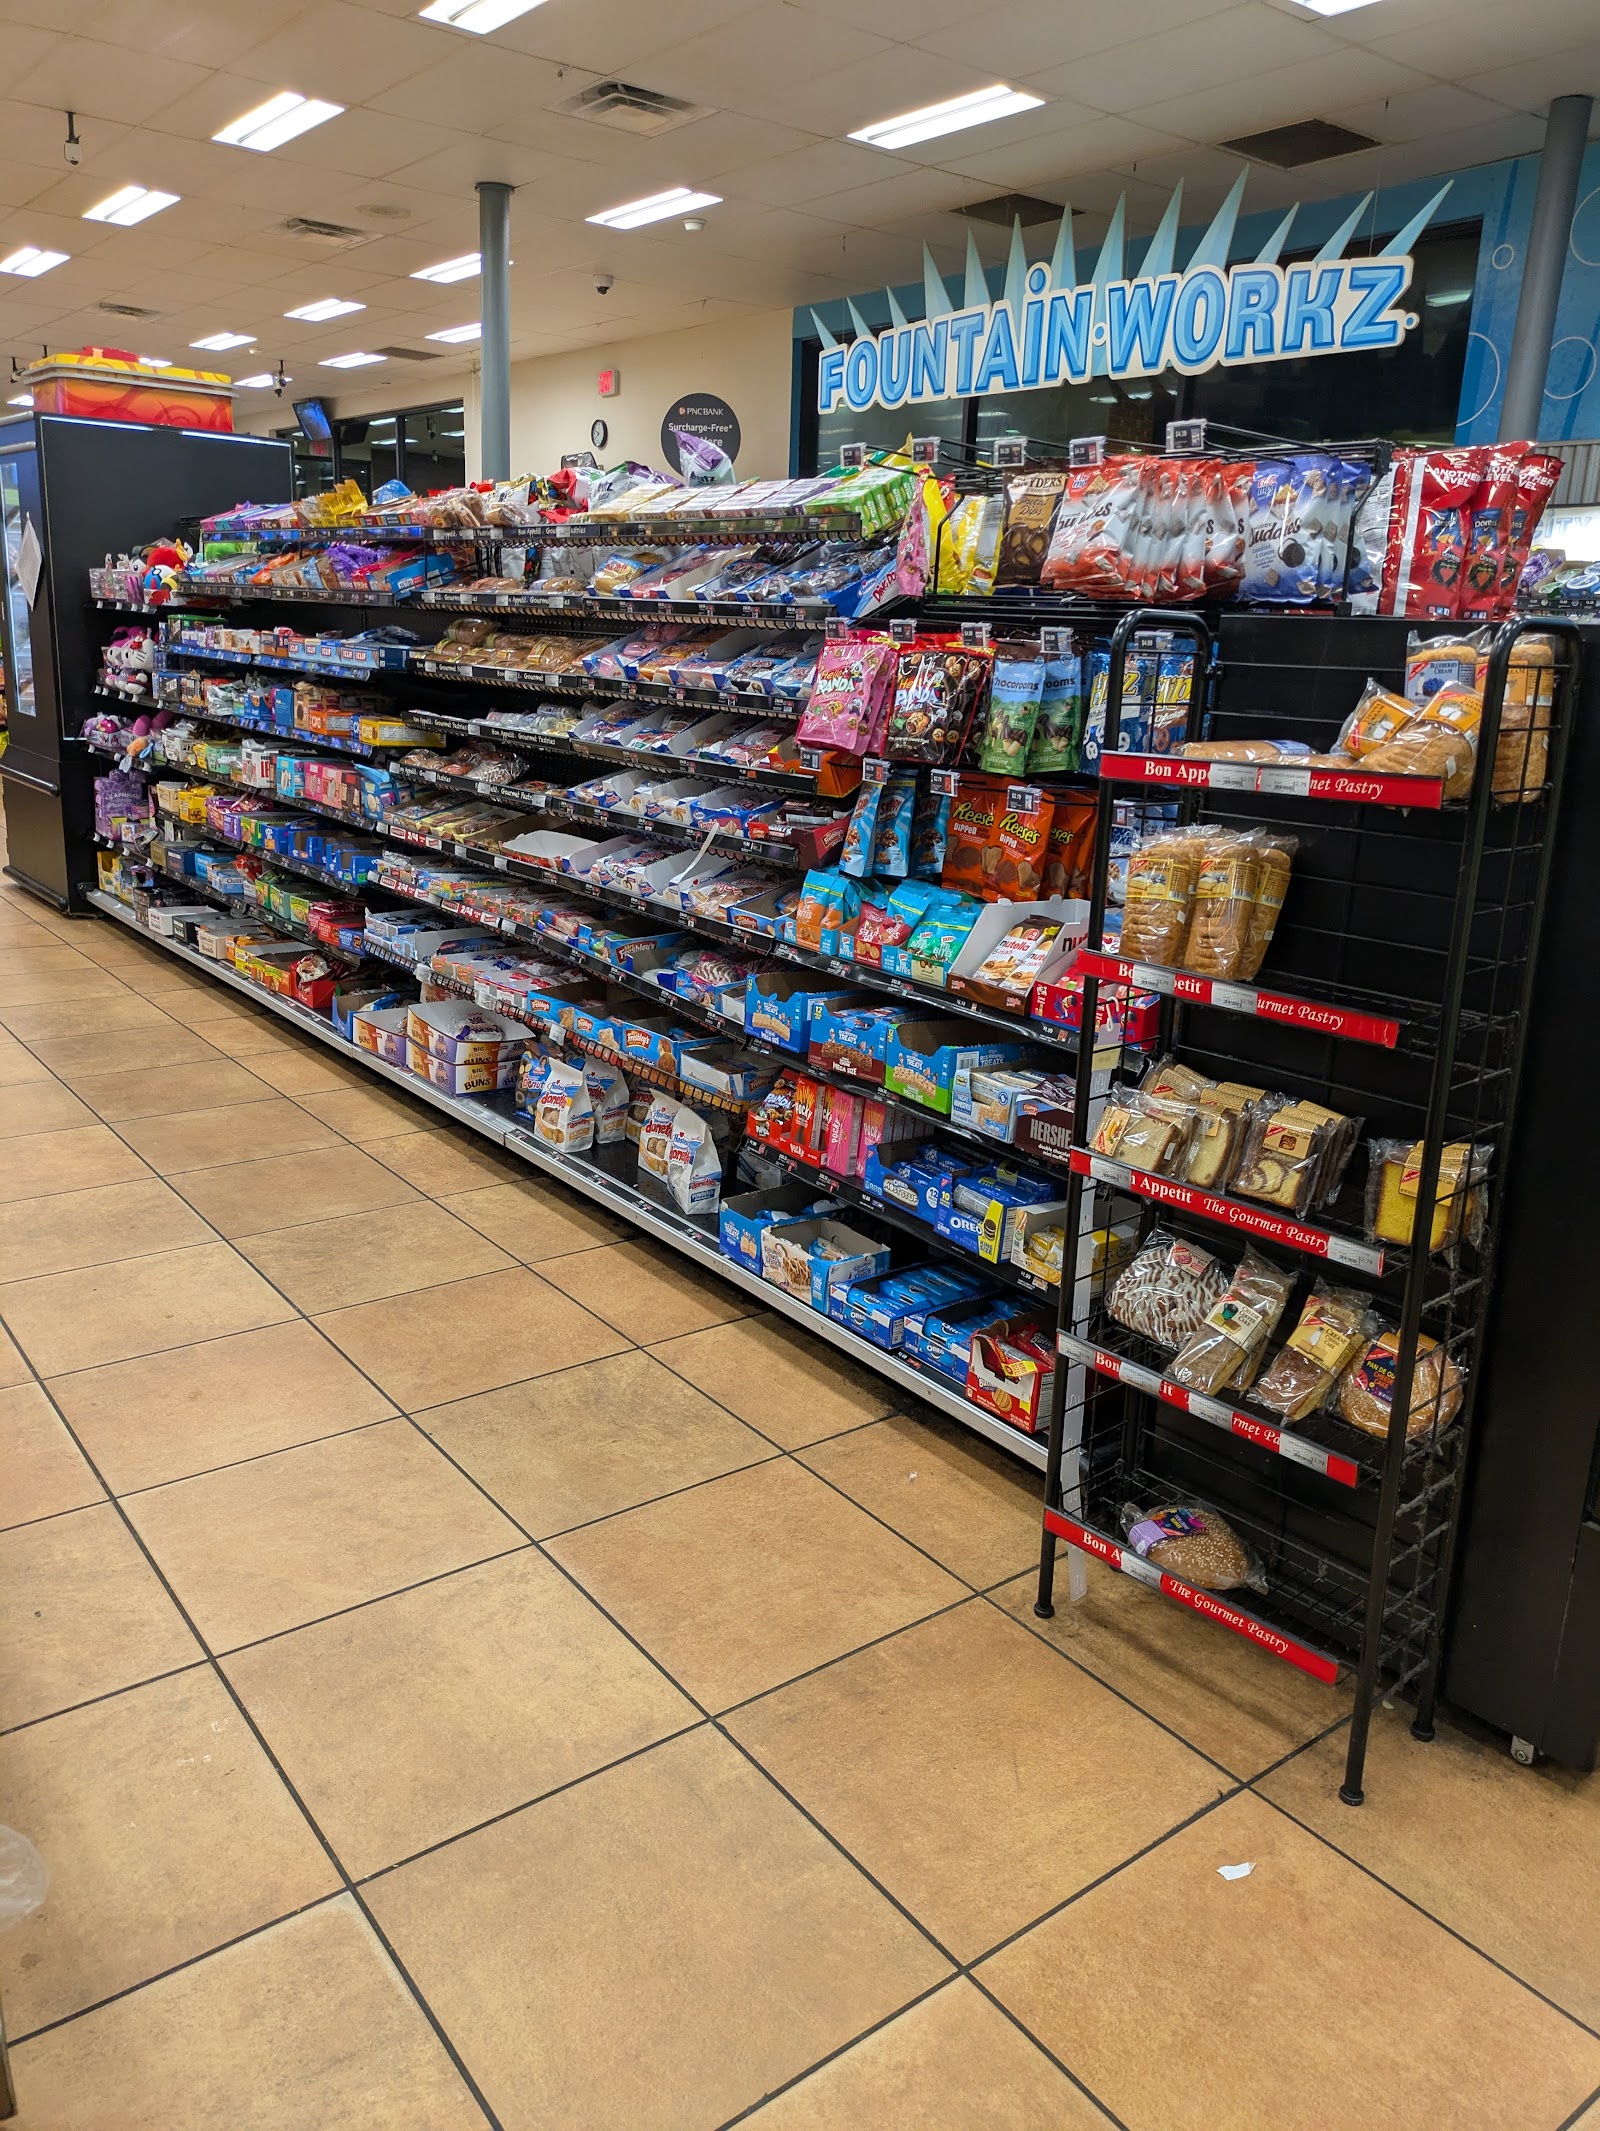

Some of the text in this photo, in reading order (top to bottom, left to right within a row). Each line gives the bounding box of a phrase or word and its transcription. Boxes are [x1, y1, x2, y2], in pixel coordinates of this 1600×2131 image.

[687, 407, 724, 416] PNC BANK
[1430, 661, 1458, 670] BLUEBERRY
[815, 676, 856, 696] PANDA
[518, 732, 537, 742] Gourmet
[538, 736, 556, 746] Pastries
[1144, 760, 1176, 778] Bon
[500, 788, 521, 799] Gourmet
[1335, 777, 1384, 800] Pastry
[999, 812, 1041, 845] Reese's
[1051, 827, 1074, 846] ese's
[999, 940, 1030, 951] nutella
[1174, 978, 1202, 995] etit
[1297, 1004, 1344, 1032] Pastry
[627, 1032, 651, 1047] Freshley's
[838, 1033, 857, 1045] TREATS
[832, 1063, 857, 1076] MEGA SIZE
[907, 1059, 923, 1070] TREATS
[981, 1059, 1004, 1067] TREATS
[464, 1077, 491, 1091] BUNS
[929, 1188, 938, 1198] 12
[941, 1190, 950, 1201] 10
[1140, 1173, 1330, 1254] Appetit The Gourmet Pastry
[950, 1216, 983, 1236] OREO
[1242, 1305, 1260, 1320] CHEESE
[1238, 1316, 1252, 1327] CAKE
[1325, 1328, 1347, 1345] CREAM
[926, 1345, 945, 1355] OREO
[1324, 1340, 1337, 1351] CAKE
[1095, 1351, 1120, 1373] Bon
[1366, 1360, 1388, 1376] PAN DE
[1373, 1371, 1395, 1386] CHEESE
[1373, 1378, 1389, 1390] CAKE
[1082, 1531, 1108, 1555] Bon
[1169, 1579, 1289, 1654] The Gourmet Pastry
